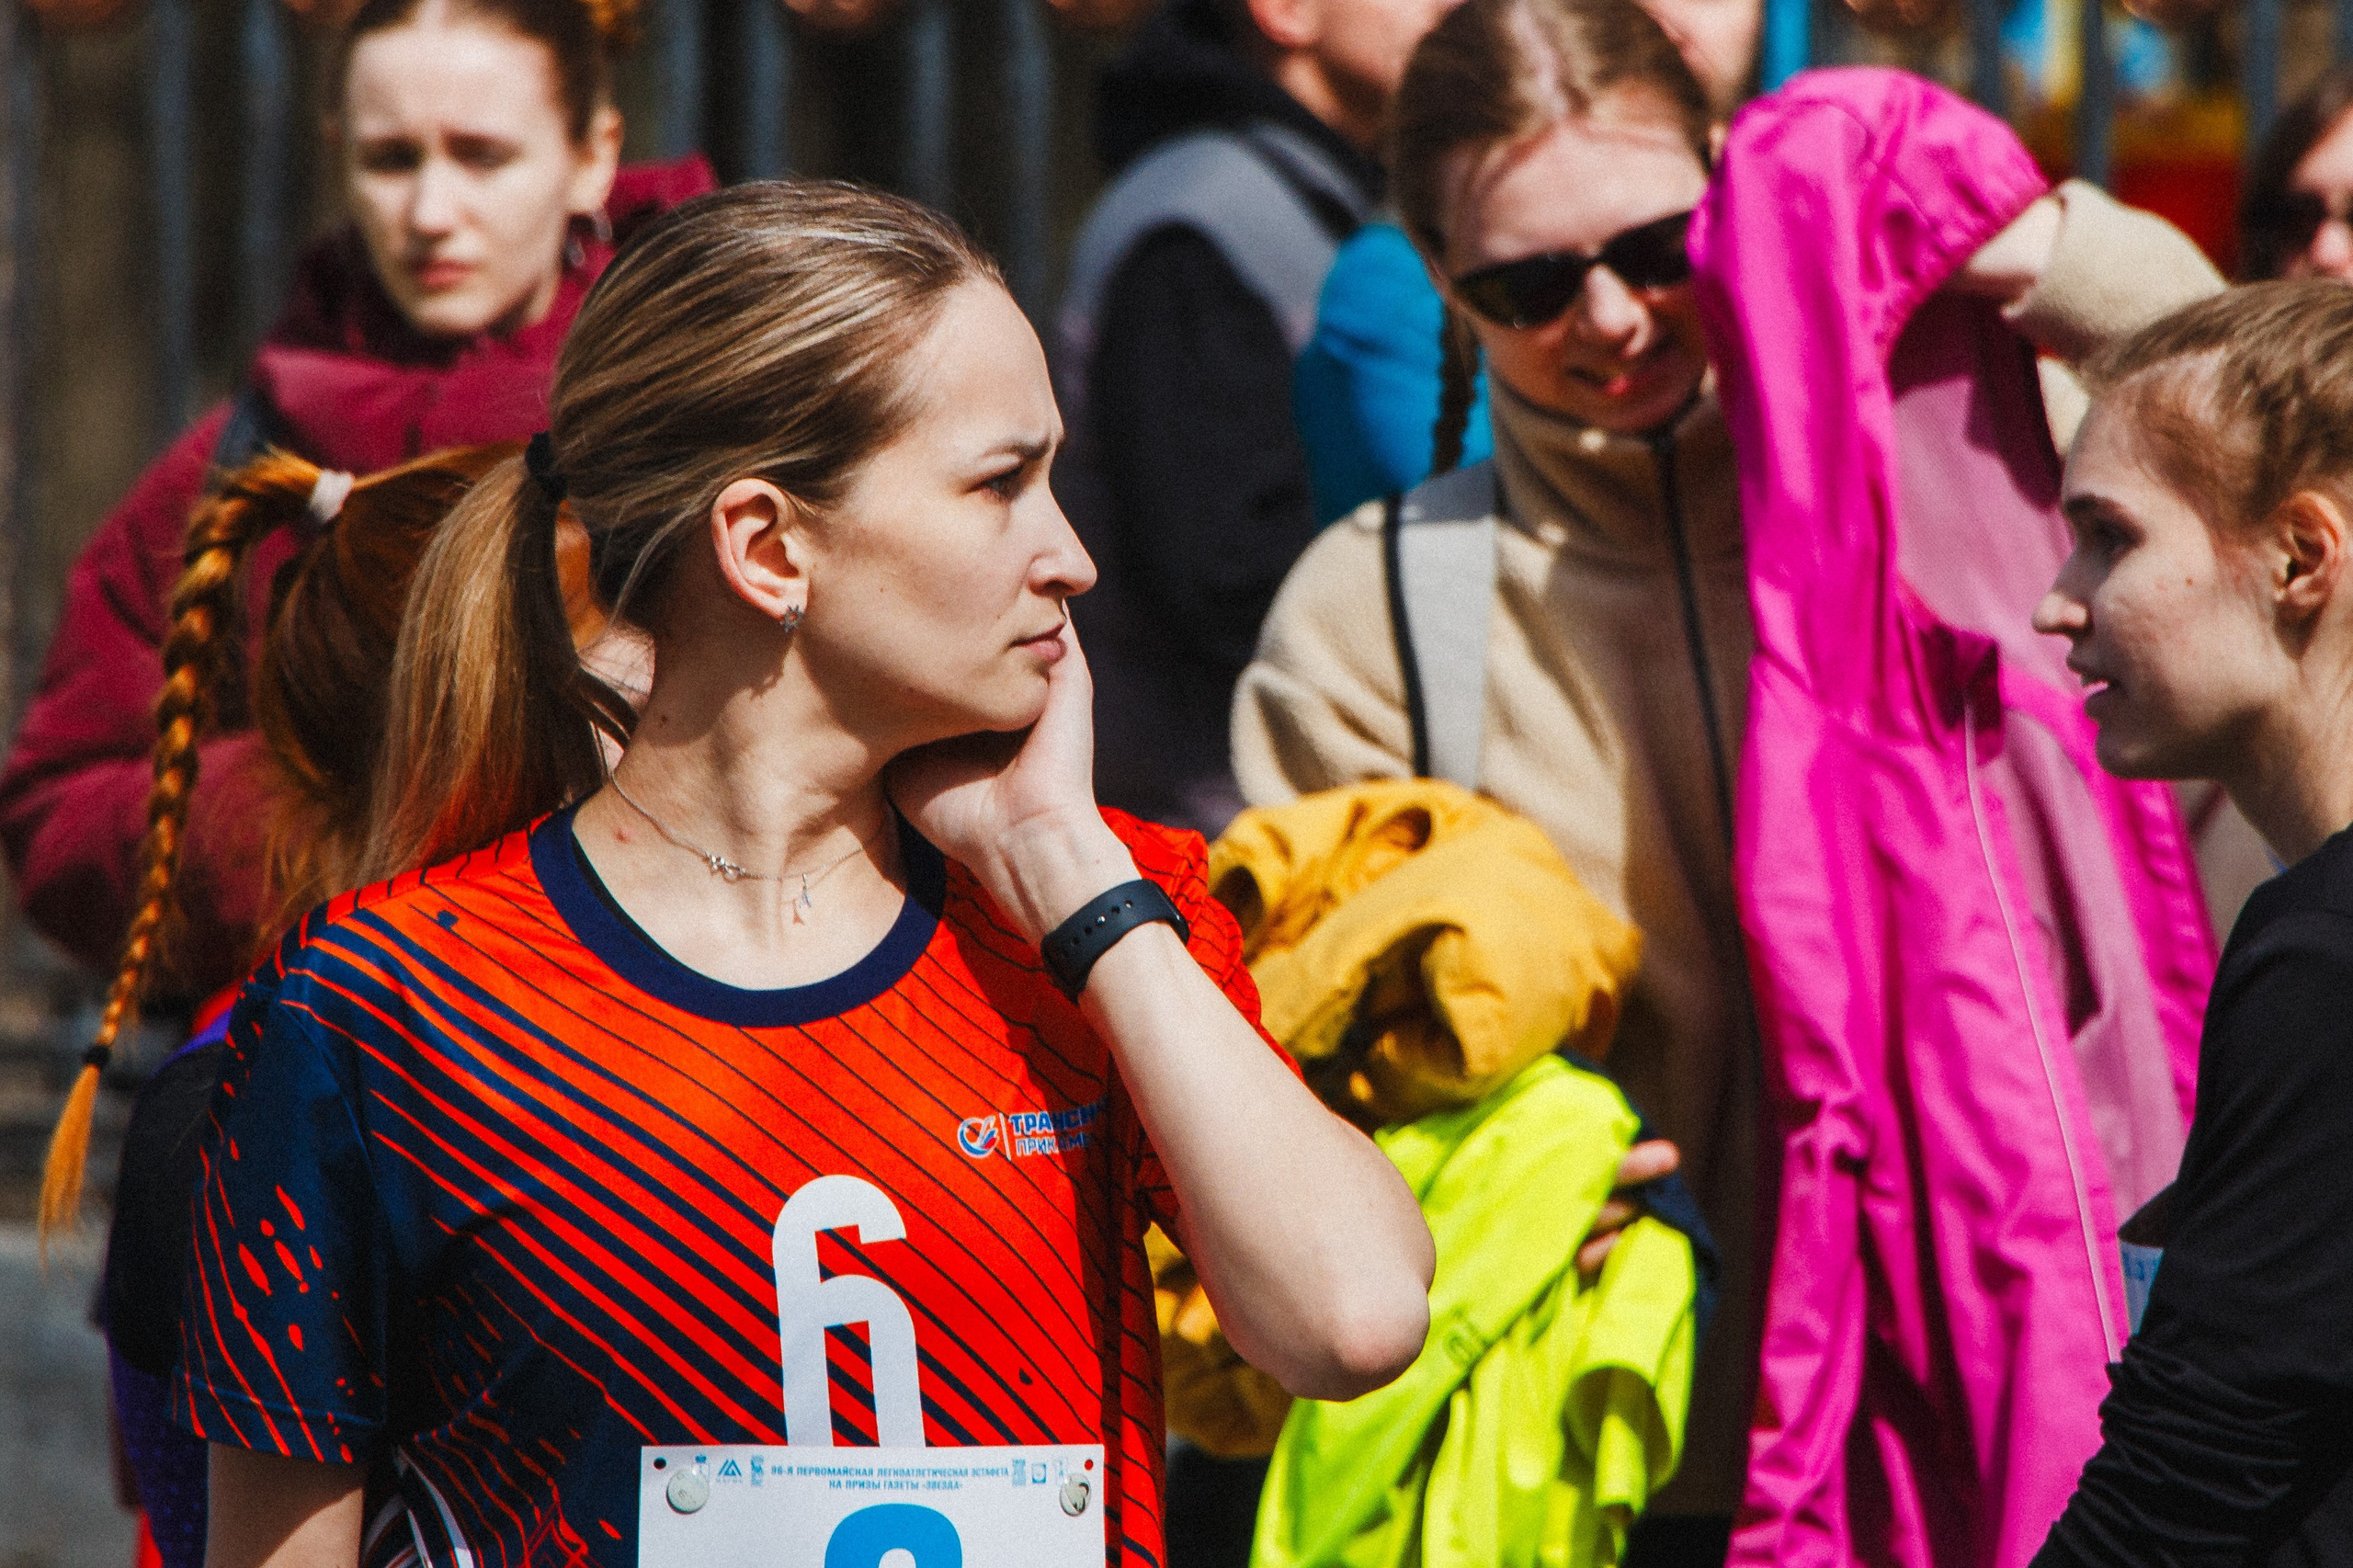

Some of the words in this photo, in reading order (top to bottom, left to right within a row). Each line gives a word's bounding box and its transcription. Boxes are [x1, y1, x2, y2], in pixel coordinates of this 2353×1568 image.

[796, 1465, 874, 1477] ПЕРВОМАЙСКАЯ
[877, 1467, 969, 1477] ЛЕГКОАТЛЕТИЧЕСКАЯ
[972, 1467, 1009, 1477] ЭСТАФЕТА
[829, 1480, 842, 1489] НА
[845, 1480, 881, 1489] ПРИЗЫ
[883, 1480, 919, 1490] ГАЗЕТЫ
